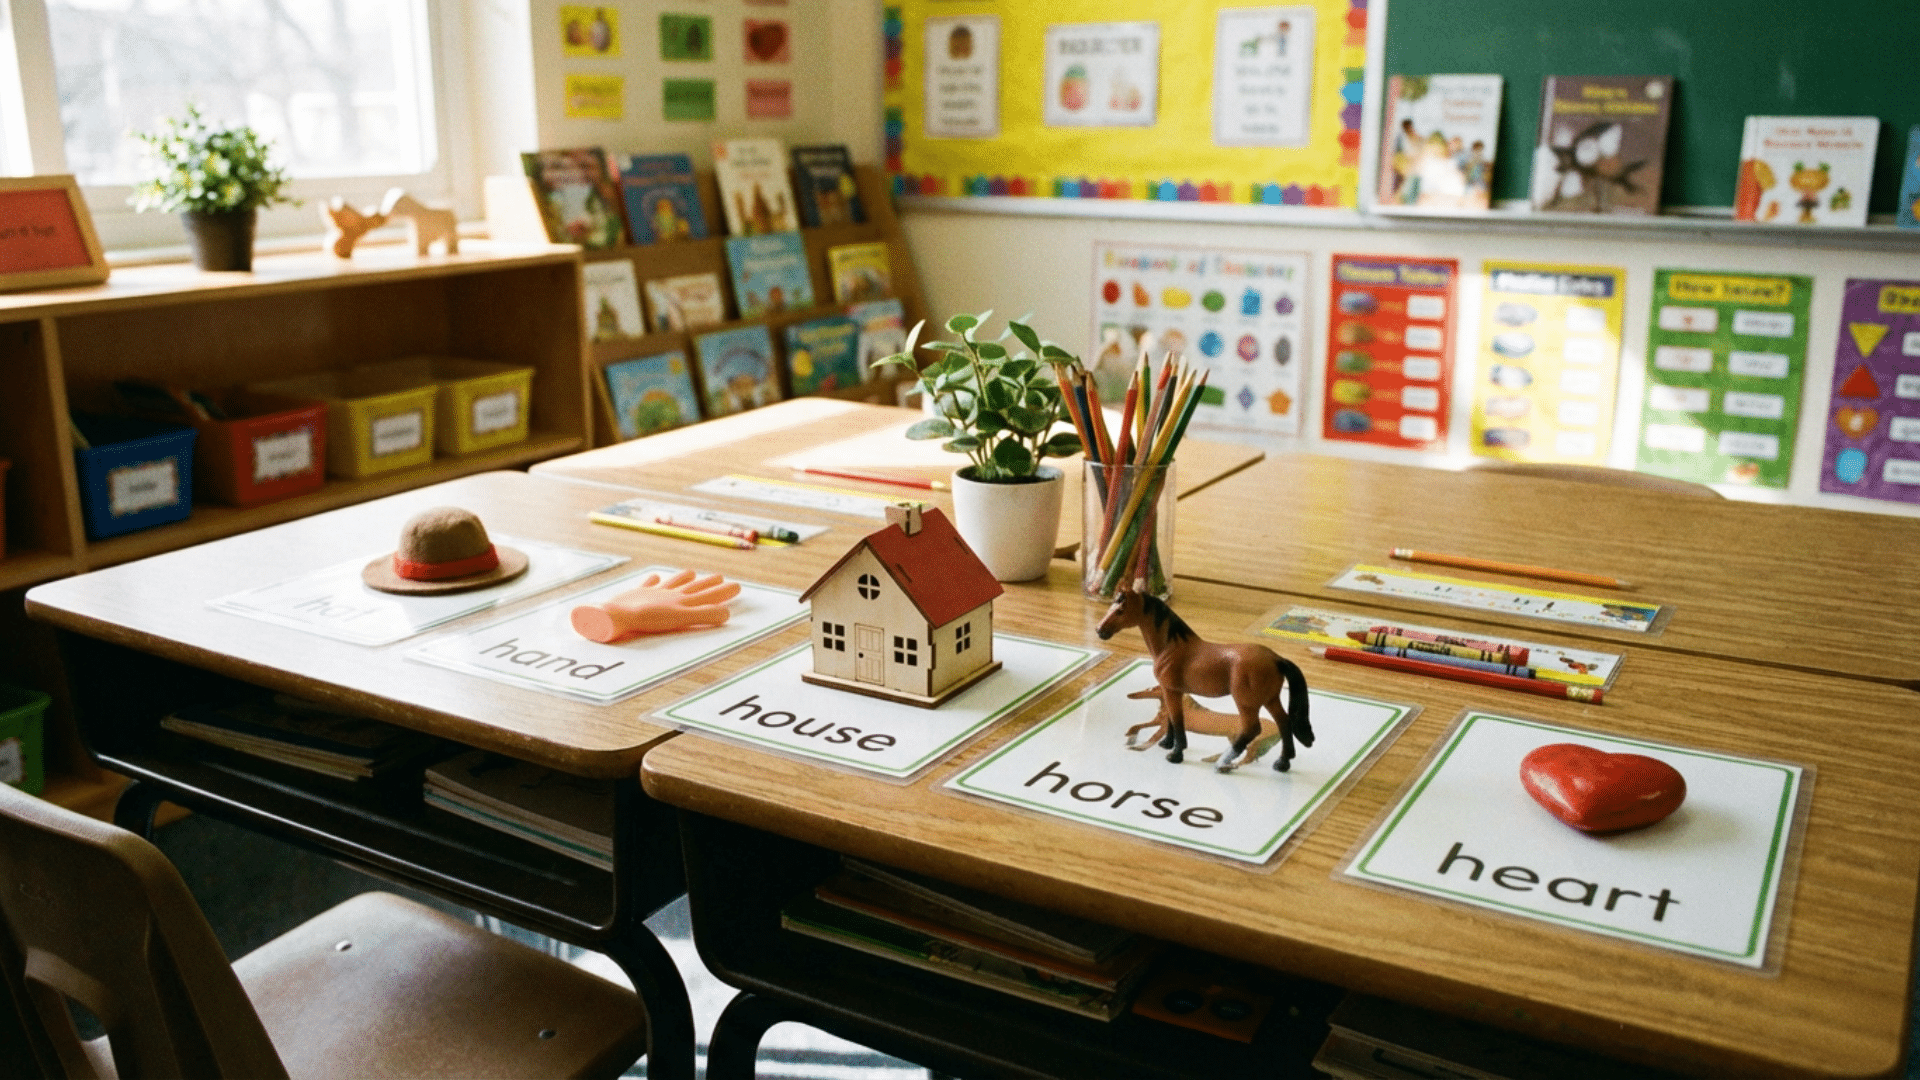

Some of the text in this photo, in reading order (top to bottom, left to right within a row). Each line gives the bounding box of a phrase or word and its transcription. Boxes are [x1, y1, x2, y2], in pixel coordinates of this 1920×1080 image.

[293, 595, 384, 622] hat
[478, 637, 625, 681] hand
[719, 694, 897, 753] house
[1024, 761, 1225, 829] horse
[1437, 842, 1681, 922] heart
